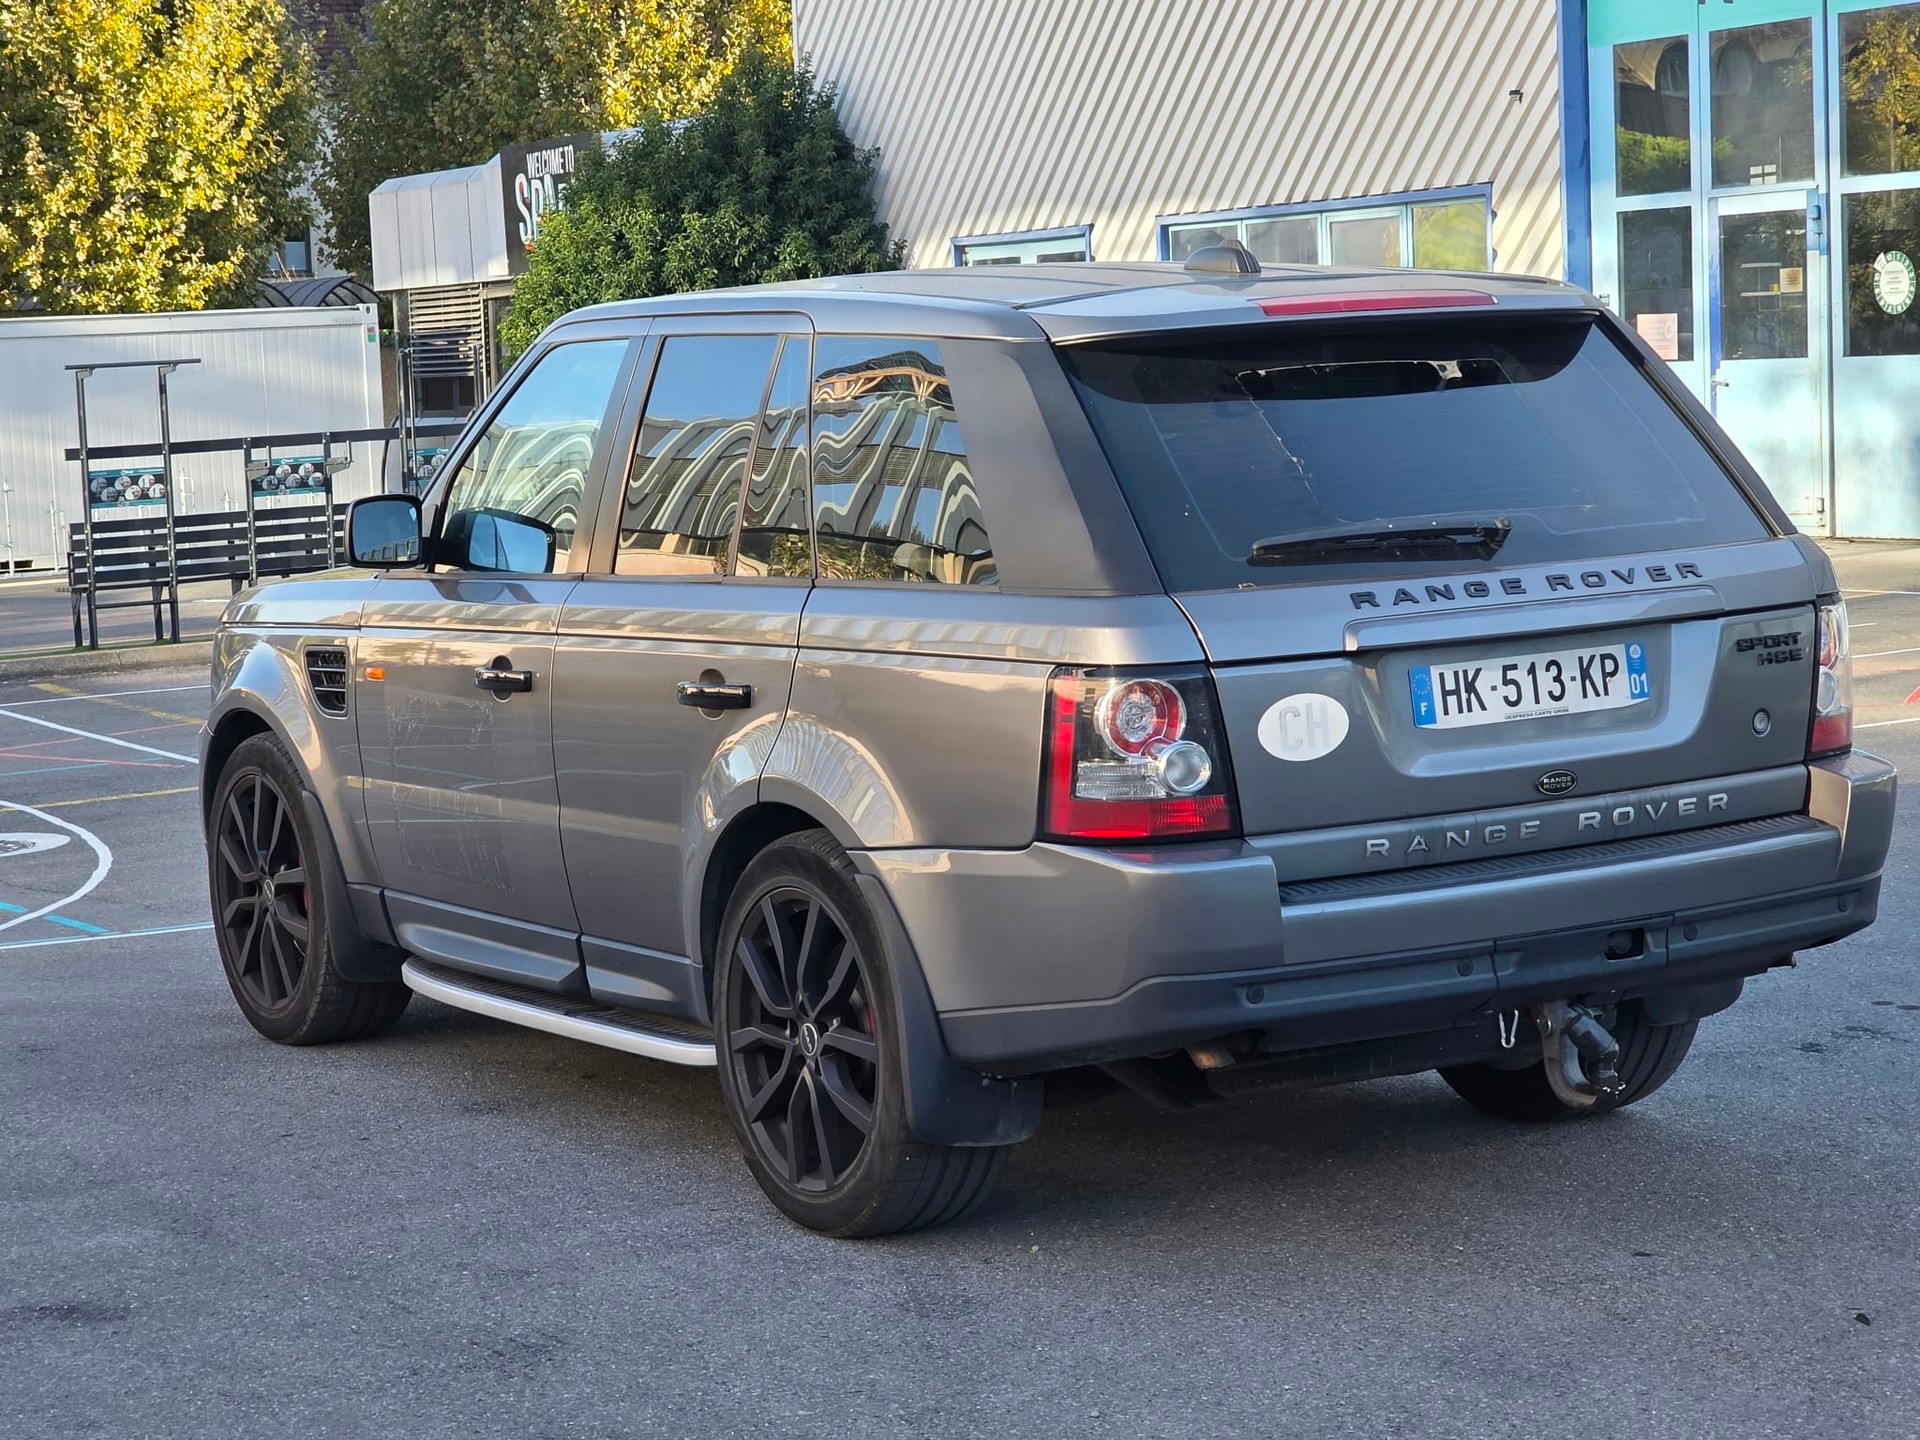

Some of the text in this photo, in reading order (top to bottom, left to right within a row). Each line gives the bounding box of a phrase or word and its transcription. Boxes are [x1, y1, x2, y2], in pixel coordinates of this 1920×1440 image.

[526, 144, 574, 179] WELCOME TO
[1349, 562, 1703, 609] RANGE ROVER
[1736, 631, 1802, 652] SPORT
[1757, 648, 1803, 666] HSE
[1438, 652, 1620, 716] HK-513-KP
[1630, 672, 1648, 694] 01
[1420, 702, 1428, 716] F
[1279, 701, 1330, 753] CH
[1543, 776, 1572, 784] RANGE
[1366, 793, 1728, 858] RANGE ROVER
